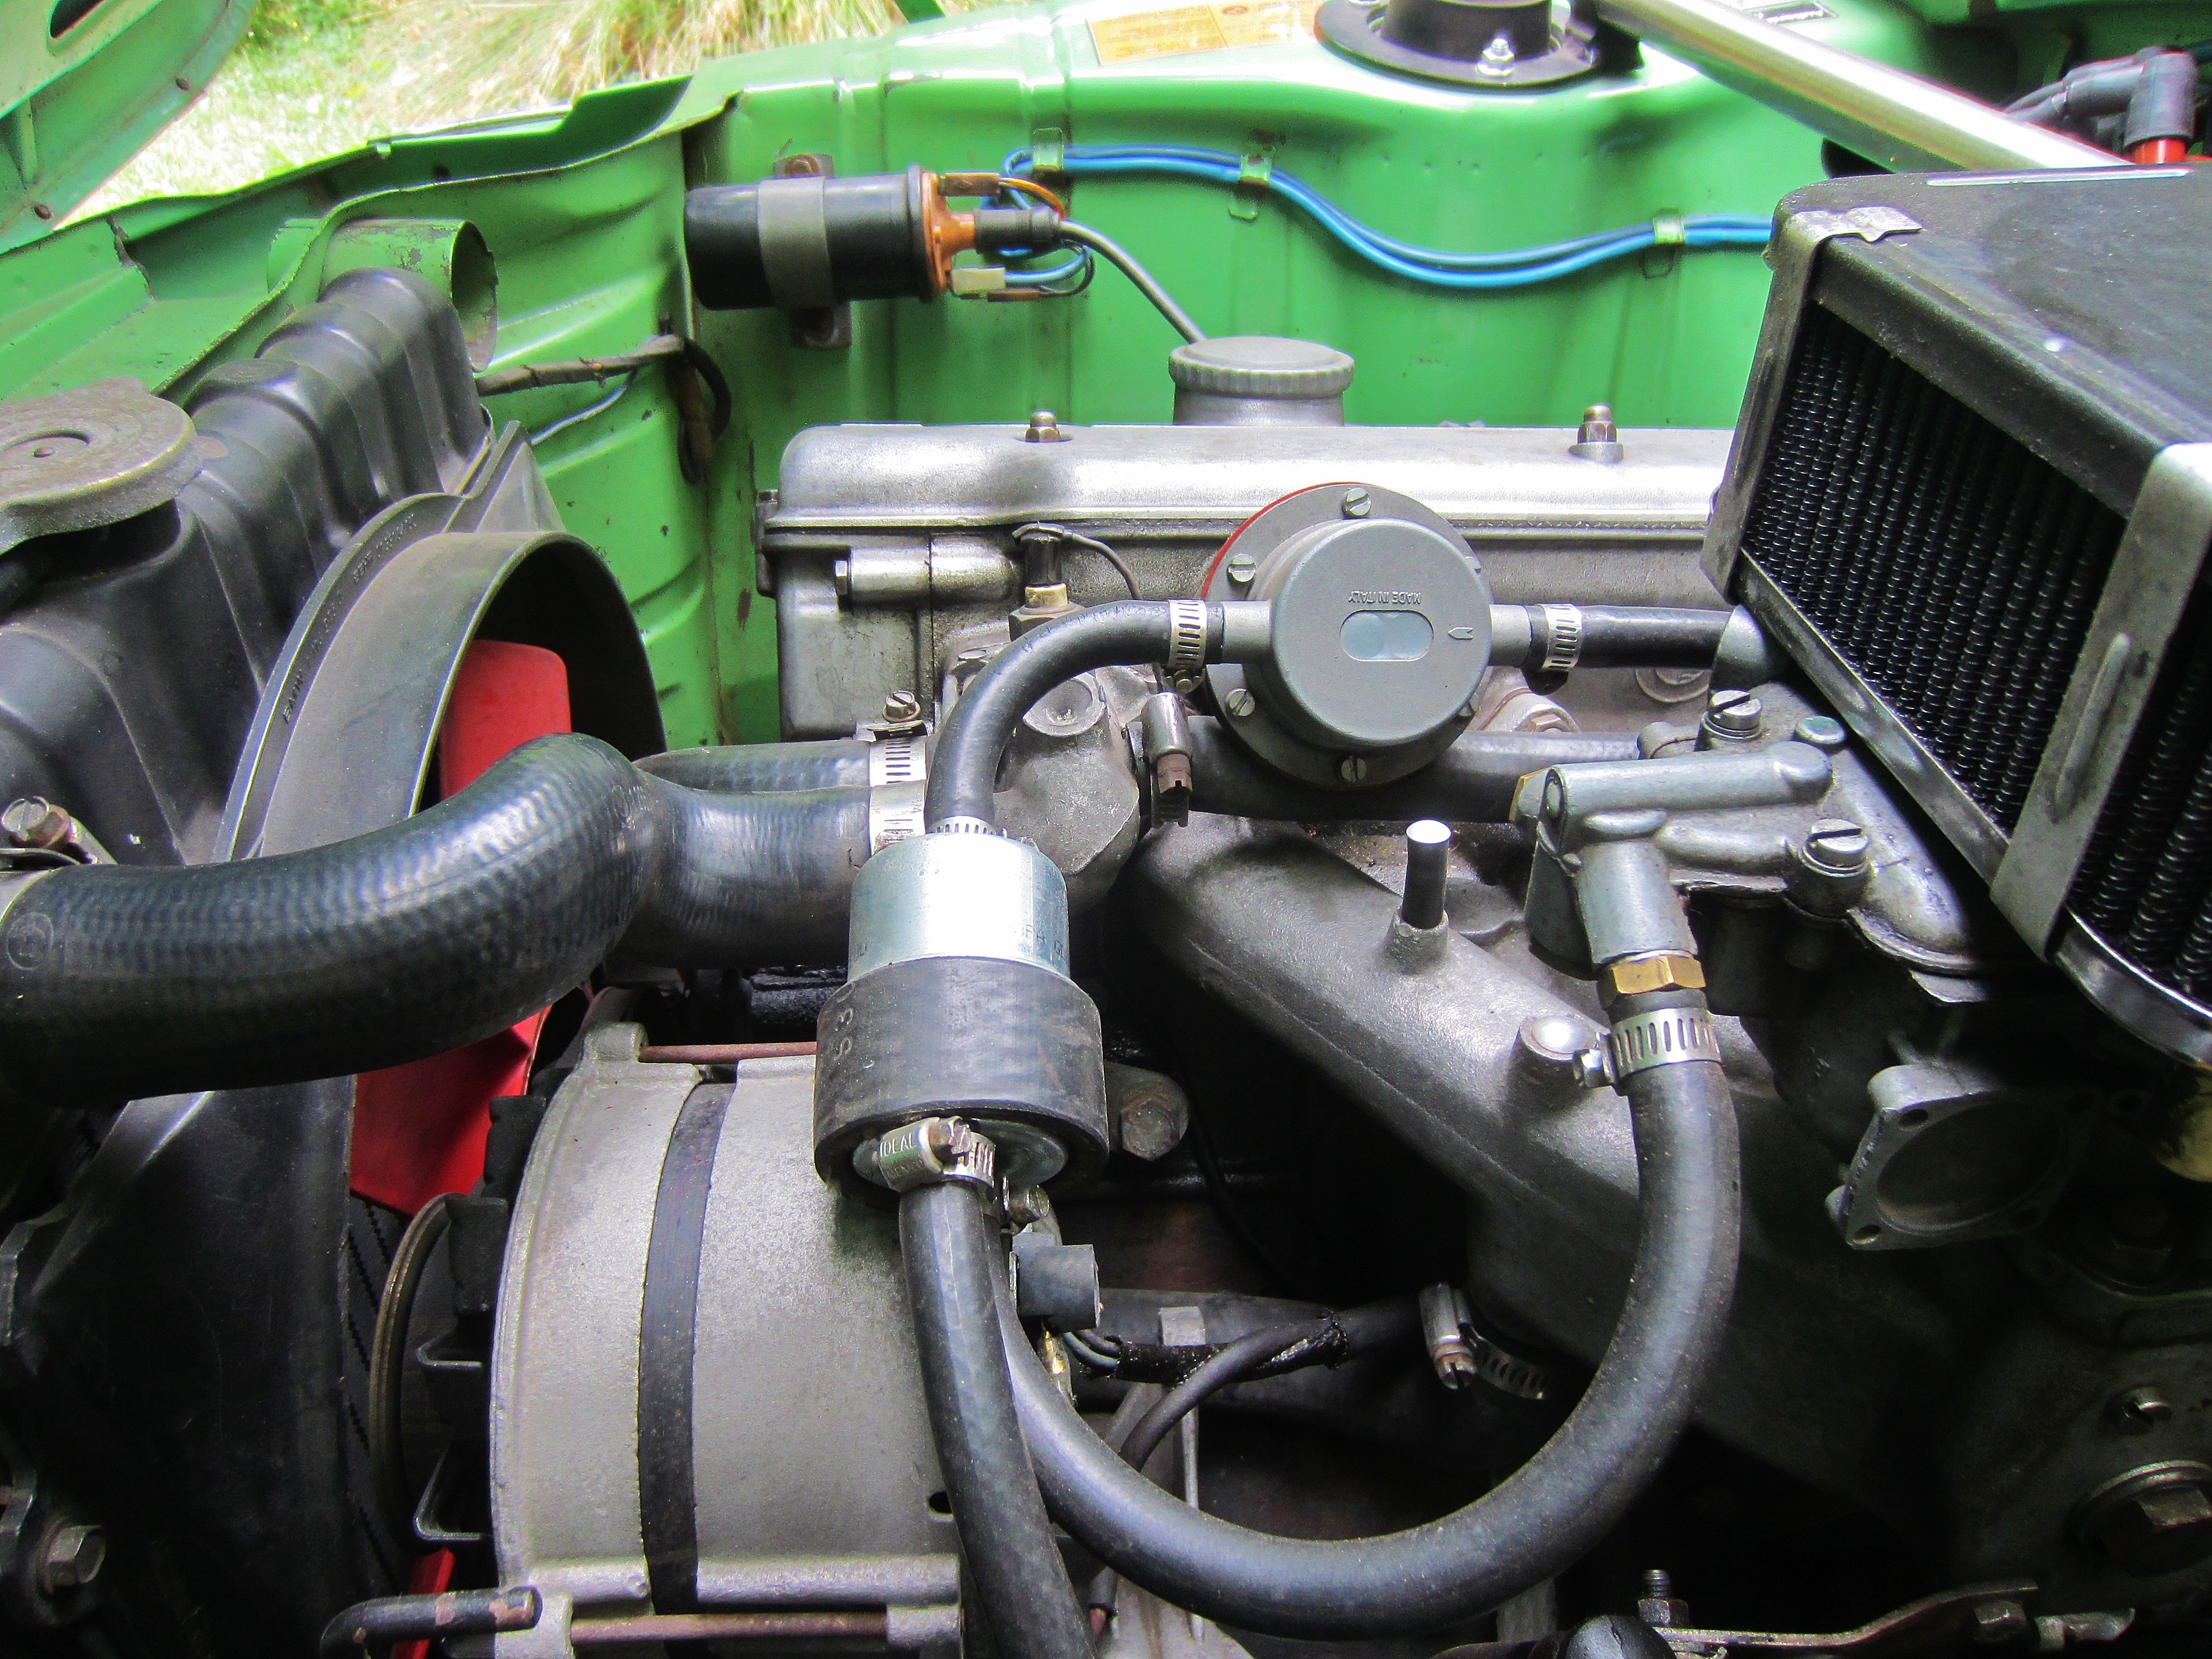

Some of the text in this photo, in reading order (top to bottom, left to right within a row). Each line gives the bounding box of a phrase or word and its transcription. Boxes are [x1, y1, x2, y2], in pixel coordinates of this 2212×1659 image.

[1348, 591, 1421, 604] MADE IN ITALY
[880, 1132, 916, 1157] IDEAL
